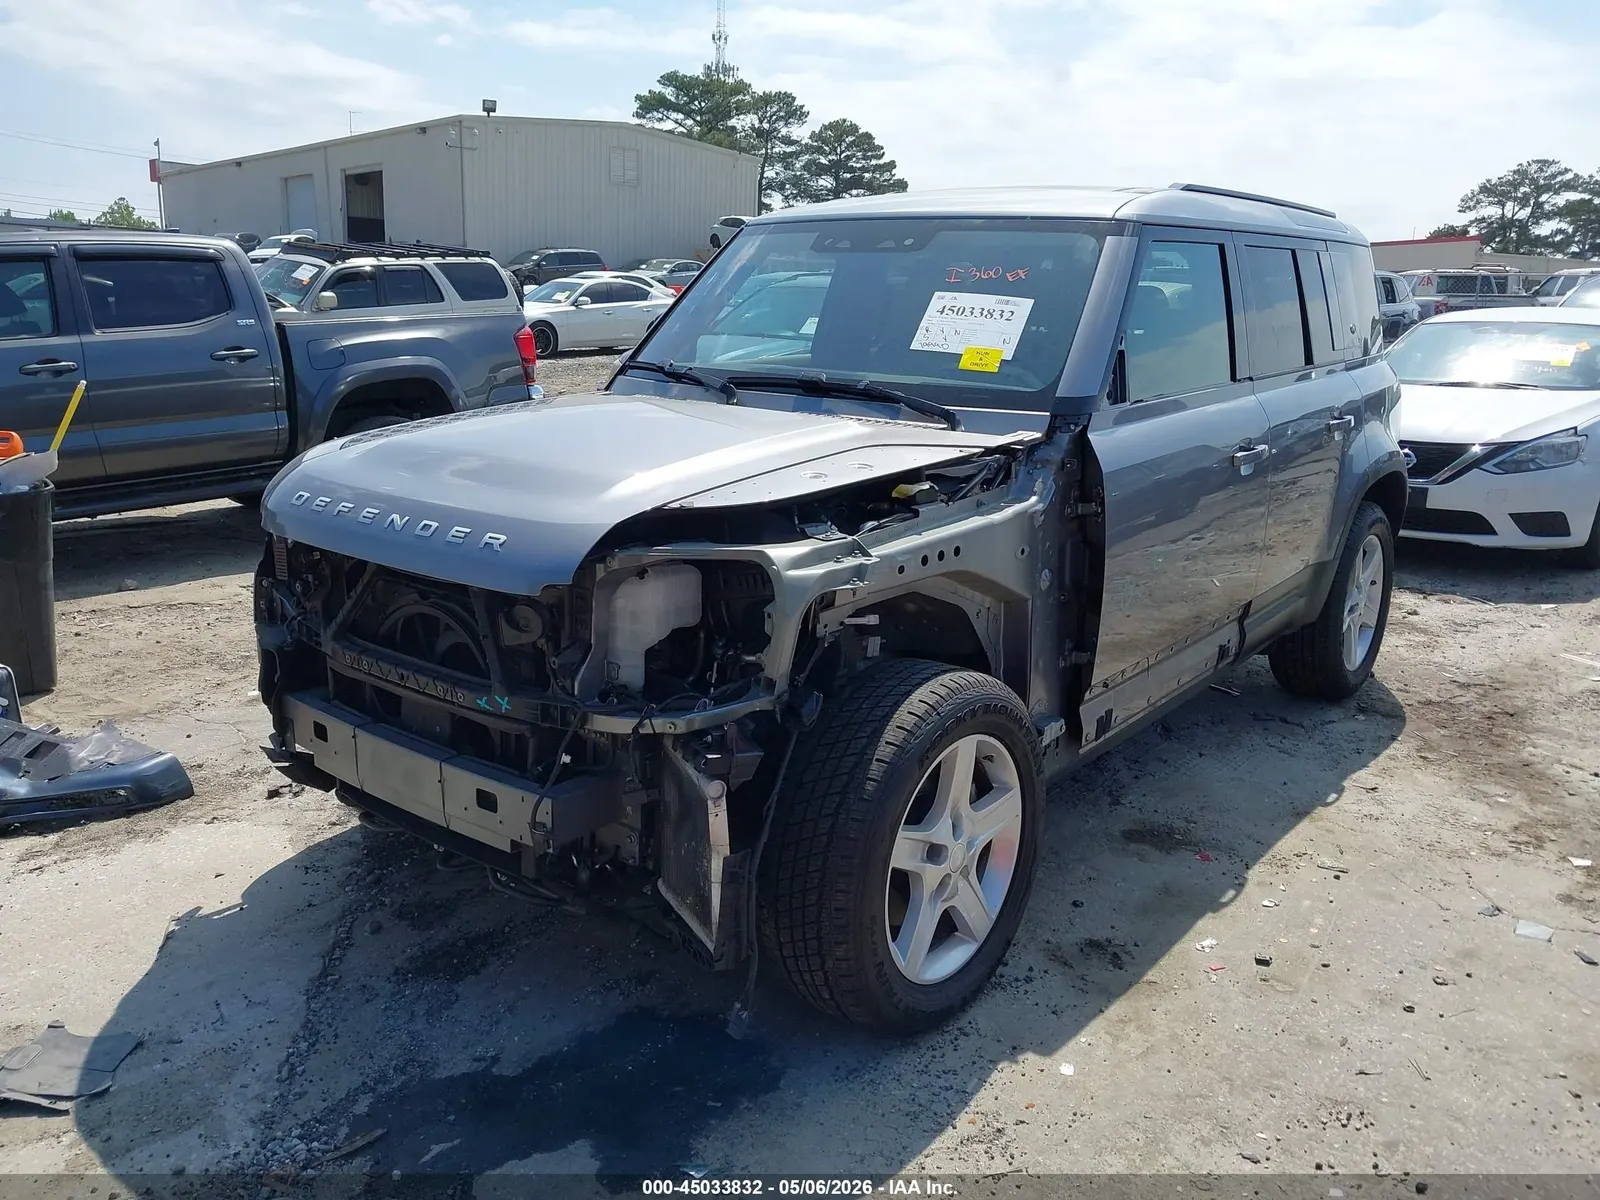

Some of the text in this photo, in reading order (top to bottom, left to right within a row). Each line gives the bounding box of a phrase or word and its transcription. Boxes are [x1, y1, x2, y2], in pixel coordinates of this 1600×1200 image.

[968, 265, 1003, 282] 360
[936, 304, 1016, 322] 45033832
[290, 490, 509, 552] DEFENDER
